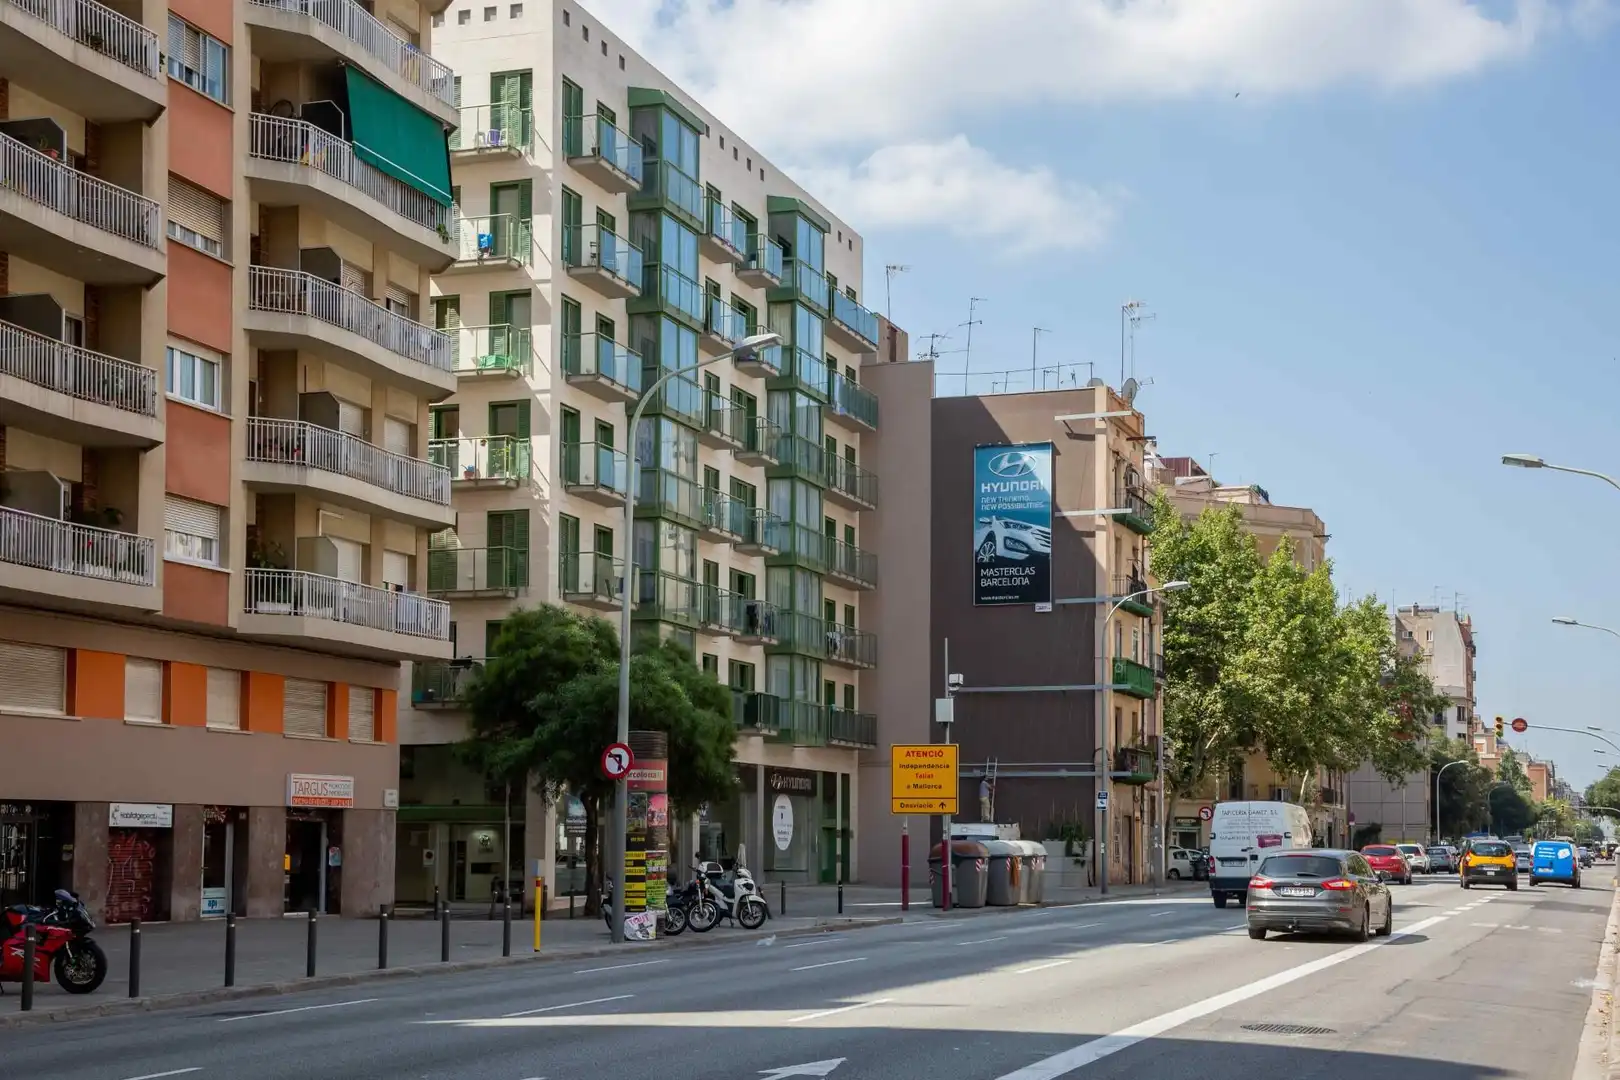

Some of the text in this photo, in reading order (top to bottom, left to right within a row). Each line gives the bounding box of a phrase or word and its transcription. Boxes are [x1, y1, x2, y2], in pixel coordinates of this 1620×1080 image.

[981, 480, 1044, 493] HYUNDAI
[981, 496, 997, 504] NEW
[981, 503, 997, 511] NEW
[980, 566, 1036, 577] MASTERCLAS
[980, 577, 1030, 587] BARCELONA
[293, 780, 328, 797] TARGUS
[783, 776, 812, 790] HYUNDAI
